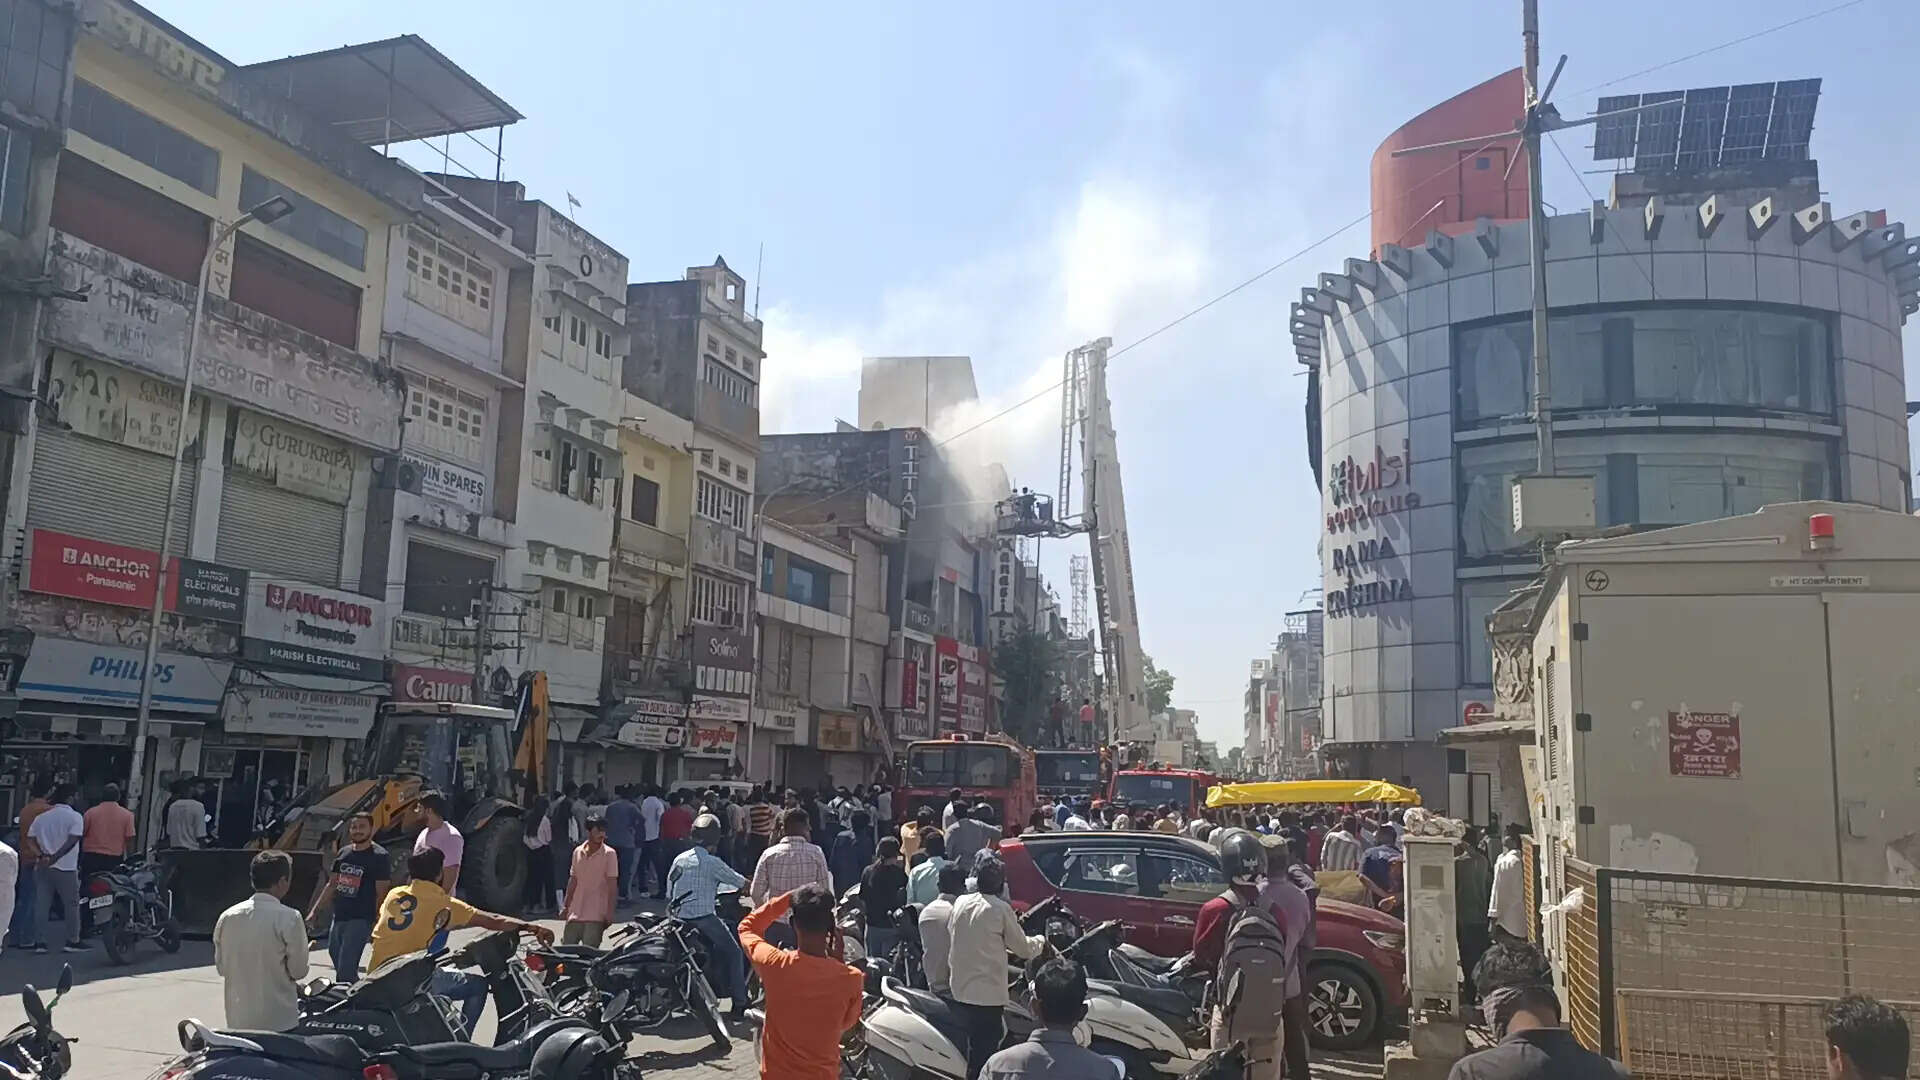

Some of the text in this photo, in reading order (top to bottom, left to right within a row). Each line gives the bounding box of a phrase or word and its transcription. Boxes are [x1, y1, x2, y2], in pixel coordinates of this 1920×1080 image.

[260, 424, 353, 471] GURUKRIPA
[442, 470, 484, 497] SPARES
[902, 445, 919, 520] TITAN
[80, 551, 149, 578] ANCHOR
[86, 573, 136, 591] Panasonic
[184, 578, 241, 597] ELECTRICALS
[286, 590, 372, 628] ANCHOR
[269, 647, 361, 671] HARISH ELECTRICALS
[405, 674, 473, 703] Canon
[1676, 713, 1730, 724] DANGER
[387, 894, 418, 931] 3
